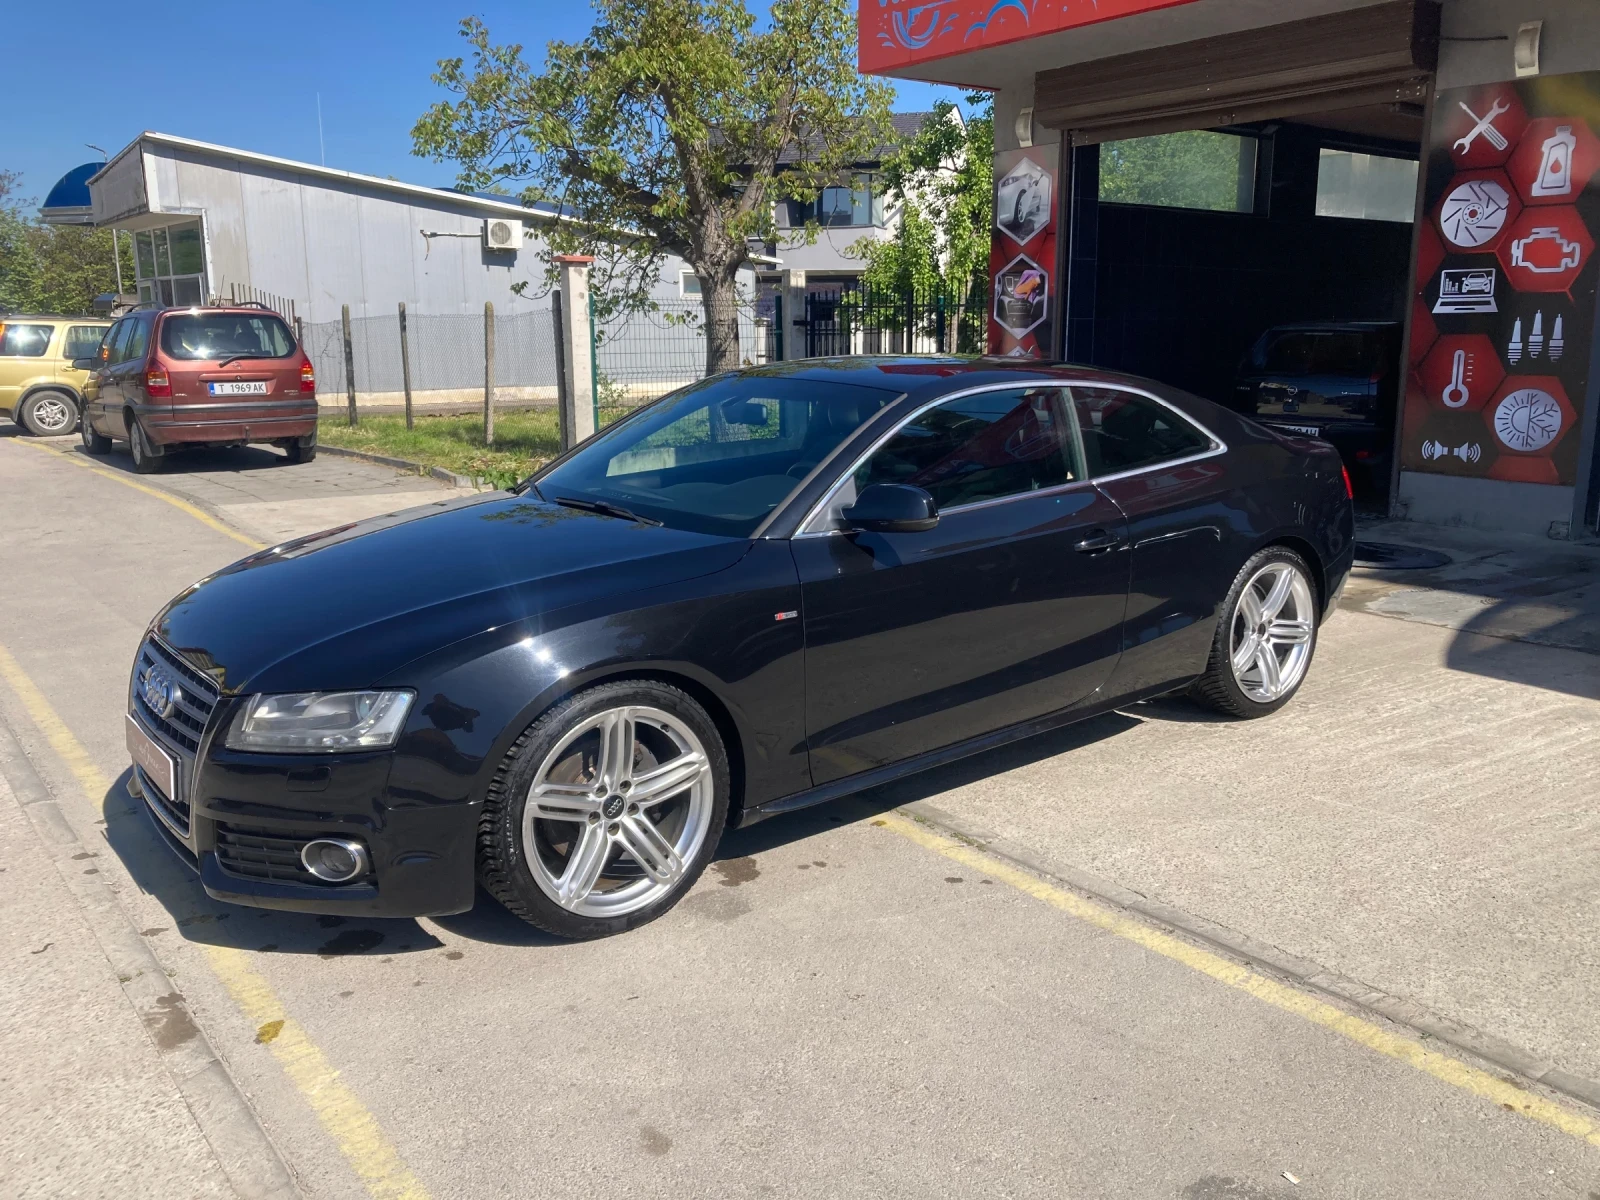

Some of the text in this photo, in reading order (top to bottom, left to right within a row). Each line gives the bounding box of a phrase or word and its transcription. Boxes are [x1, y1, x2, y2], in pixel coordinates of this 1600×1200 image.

[218, 384, 264, 393] T 1969 AK
